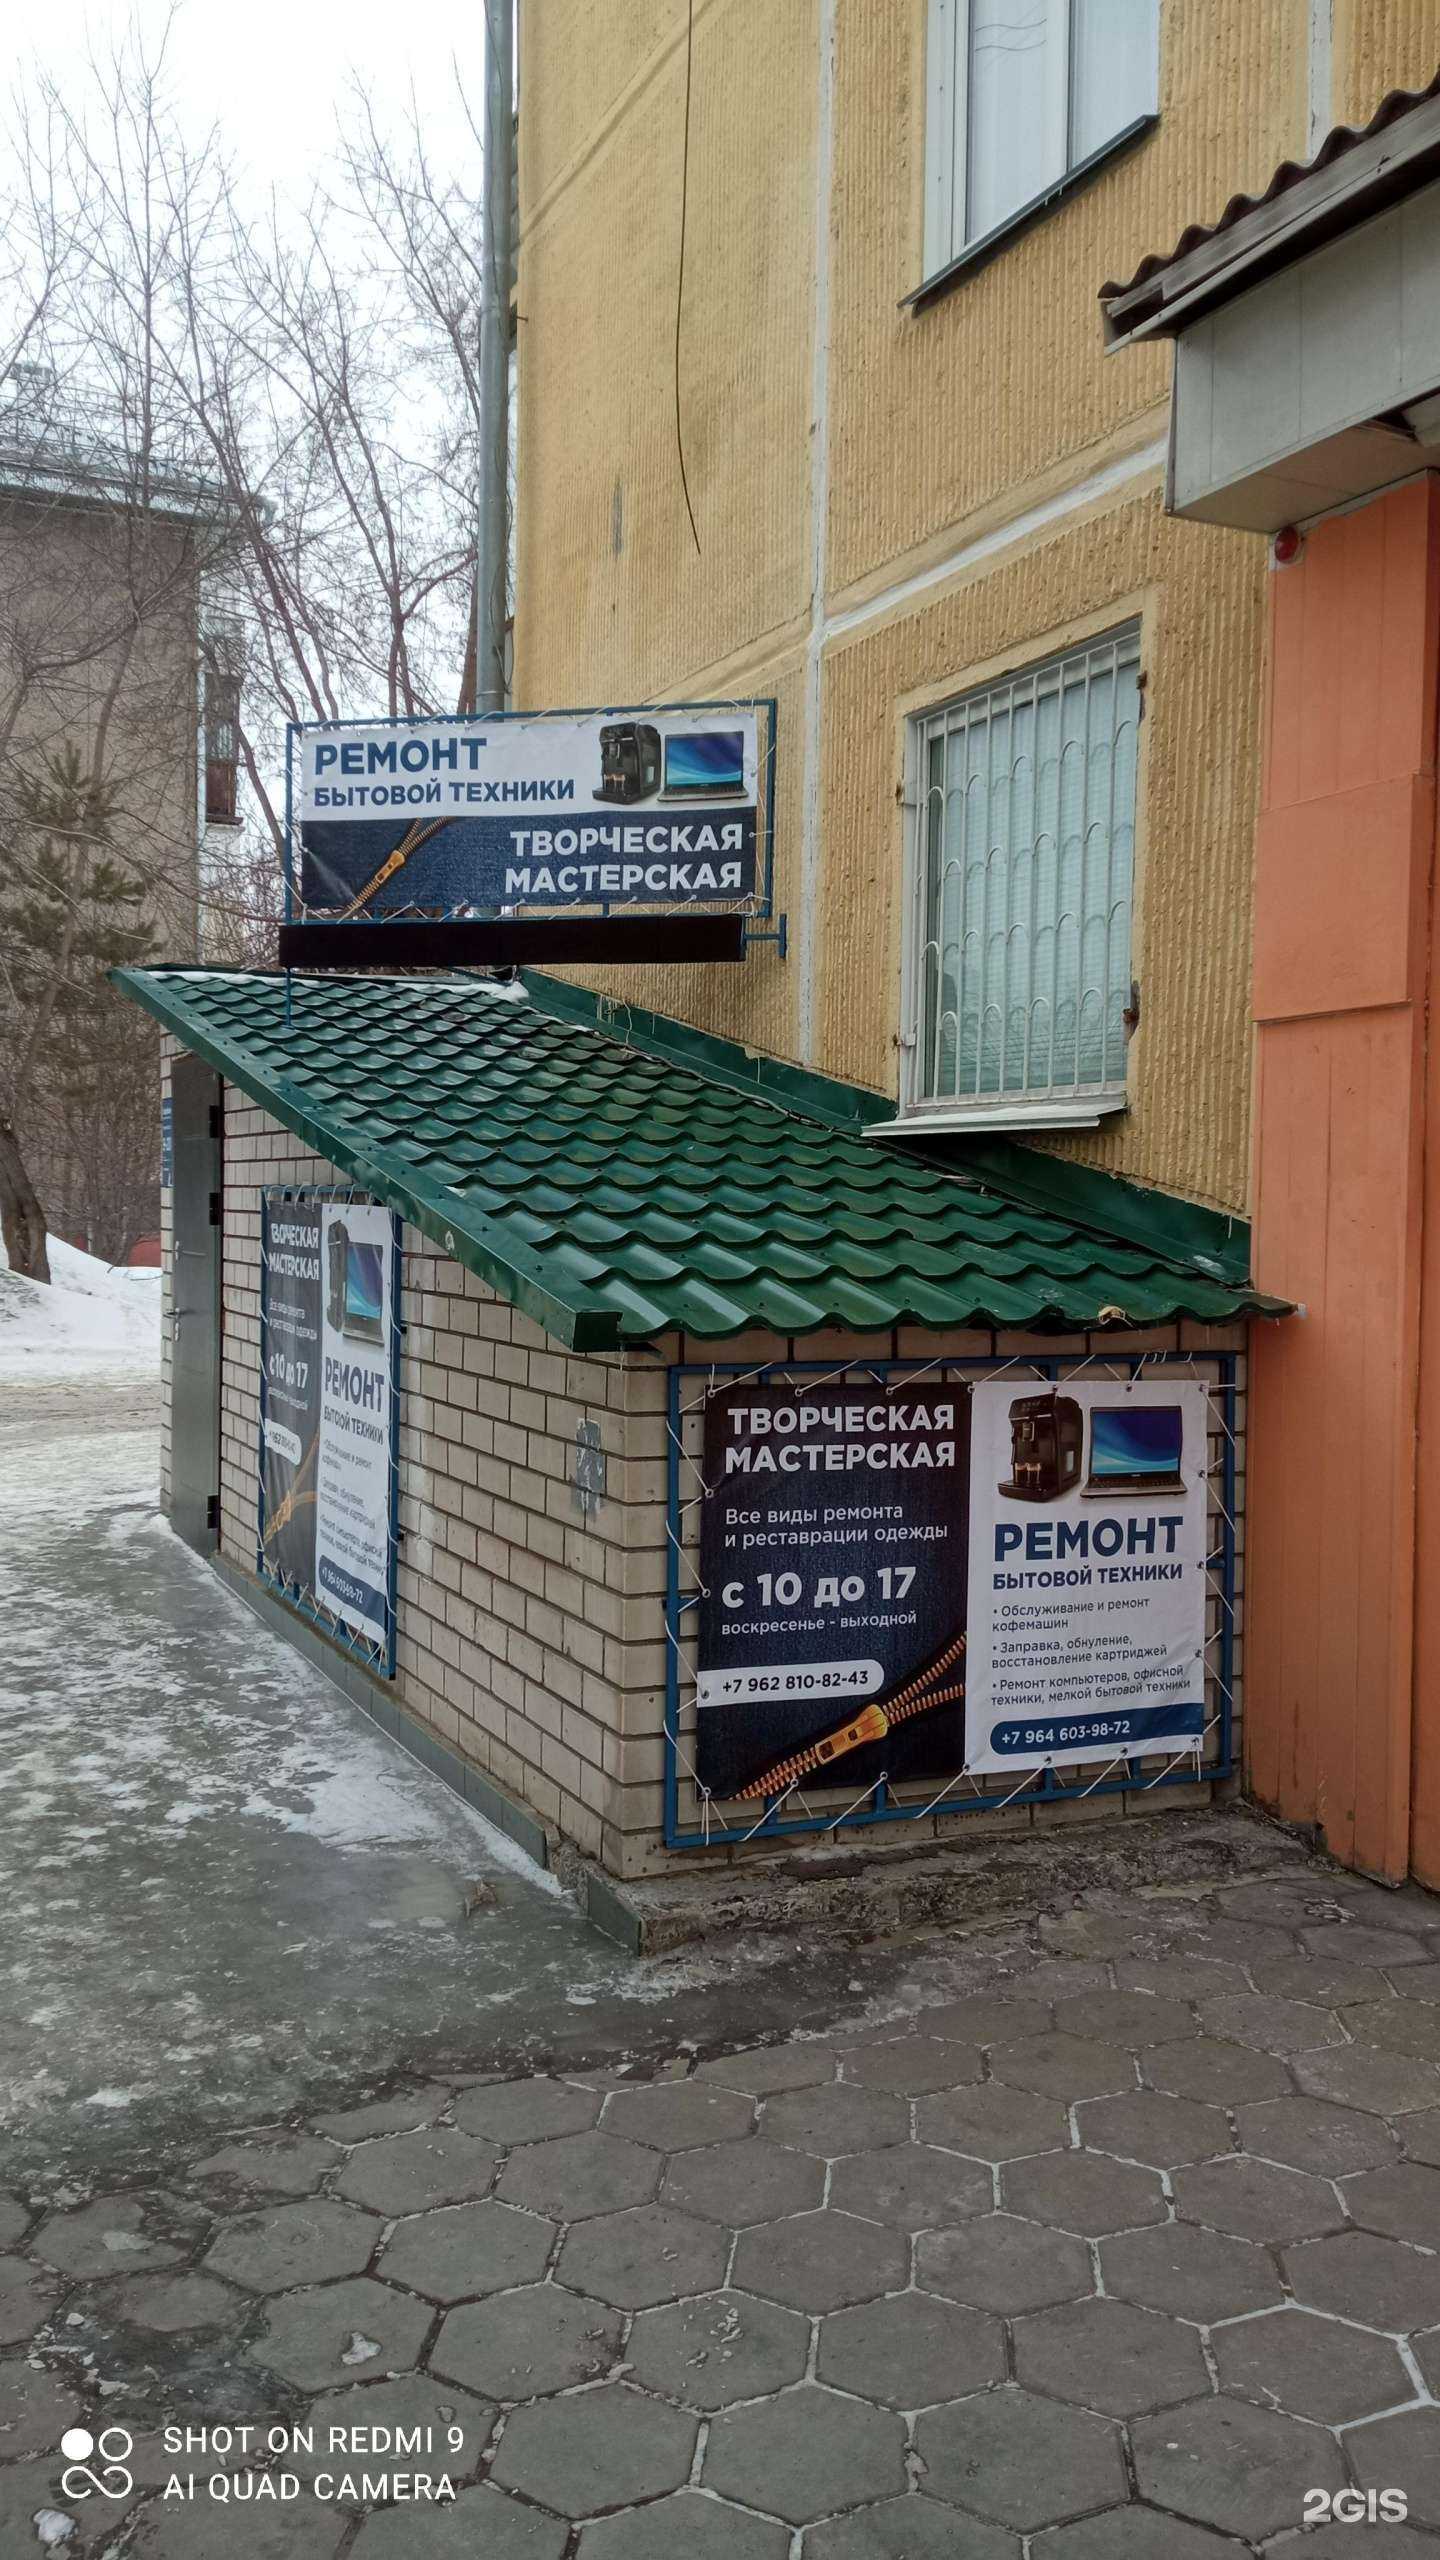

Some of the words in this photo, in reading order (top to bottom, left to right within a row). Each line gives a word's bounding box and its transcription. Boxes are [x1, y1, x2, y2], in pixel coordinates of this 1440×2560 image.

[315, 737, 487, 775] РЕМОНТ
[314, 777, 441, 807] БЫТОВОЙ
[454, 779, 575, 803] ТЕХНИКИ
[510, 823, 743, 857] ТВОРЧЕСКАЯ
[505, 862, 742, 894] МАСТЕРСКАЯ
[275, 1353, 285, 1380] 10
[295, 1360, 308, 1389] 17
[325, 1356, 384, 1412] РЕМОНТ
[351, 1417, 384, 1445] ТЕХНИКИ
[728, 1404, 954, 1435] ТВОРЧЕСКАЯ
[725, 1441, 955, 1473] МАСТЕРСКАЯ
[726, 1508, 761, 1525] Все
[768, 1507, 817, 1525] виды
[824, 1505, 903, 1524] ремонта
[725, 1535, 735, 1547] и
[743, 1529, 868, 1549] реставрации
[875, 1525, 948, 1543] одежды
[995, 1516, 1183, 1562] РЕМОНТ
[722, 1582, 744, 1608] с
[757, 1572, 802, 1606] 10
[814, 1576, 865, 1608] до
[877, 1566, 916, 1600] 17
[993, 1564, 1092, 1590] БЫТОВОЙ
[1097, 1564, 1183, 1584] ТЕХНИКИ
[722, 1617, 825, 1635] воскресенье
[841, 1610, 917, 1629] выходной
[1001, 1602, 1094, 1619] Обслуживание
[1097, 1602, 1104, 1610] и
[1107, 1598, 1150, 1612] ремонт
[992, 1619, 1069, 1633] кофемашин
[992, 1652, 1092, 1669] восстановление
[1095, 1645, 1167, 1662] картриджей
[1000, 1640, 1064, 1655] Заправка,
[1066, 1634, 1133, 1650] обнуление,
[722, 1679, 742, 1693] +7
[748, 1677, 780, 1692] 962
[786, 1670, 869, 1690] 810-82-43
[991, 1692, 1045, 1706] техники,
[1049, 1686, 1092, 1702] мелкой
[1095, 1682, 1143, 1699] бытовой
[1147, 1678, 1191, 1693] техники
[1000, 1678, 1046, 1691] Ремонт
[1049, 1671, 1130, 1688] компьютеров,
[1133, 1665, 1184, 1681] офисной
[1001, 1730, 1020, 1745] +7
[1025, 1727, 1054, 1744] 964
[1059, 1720, 1131, 1741] 603-98-72
